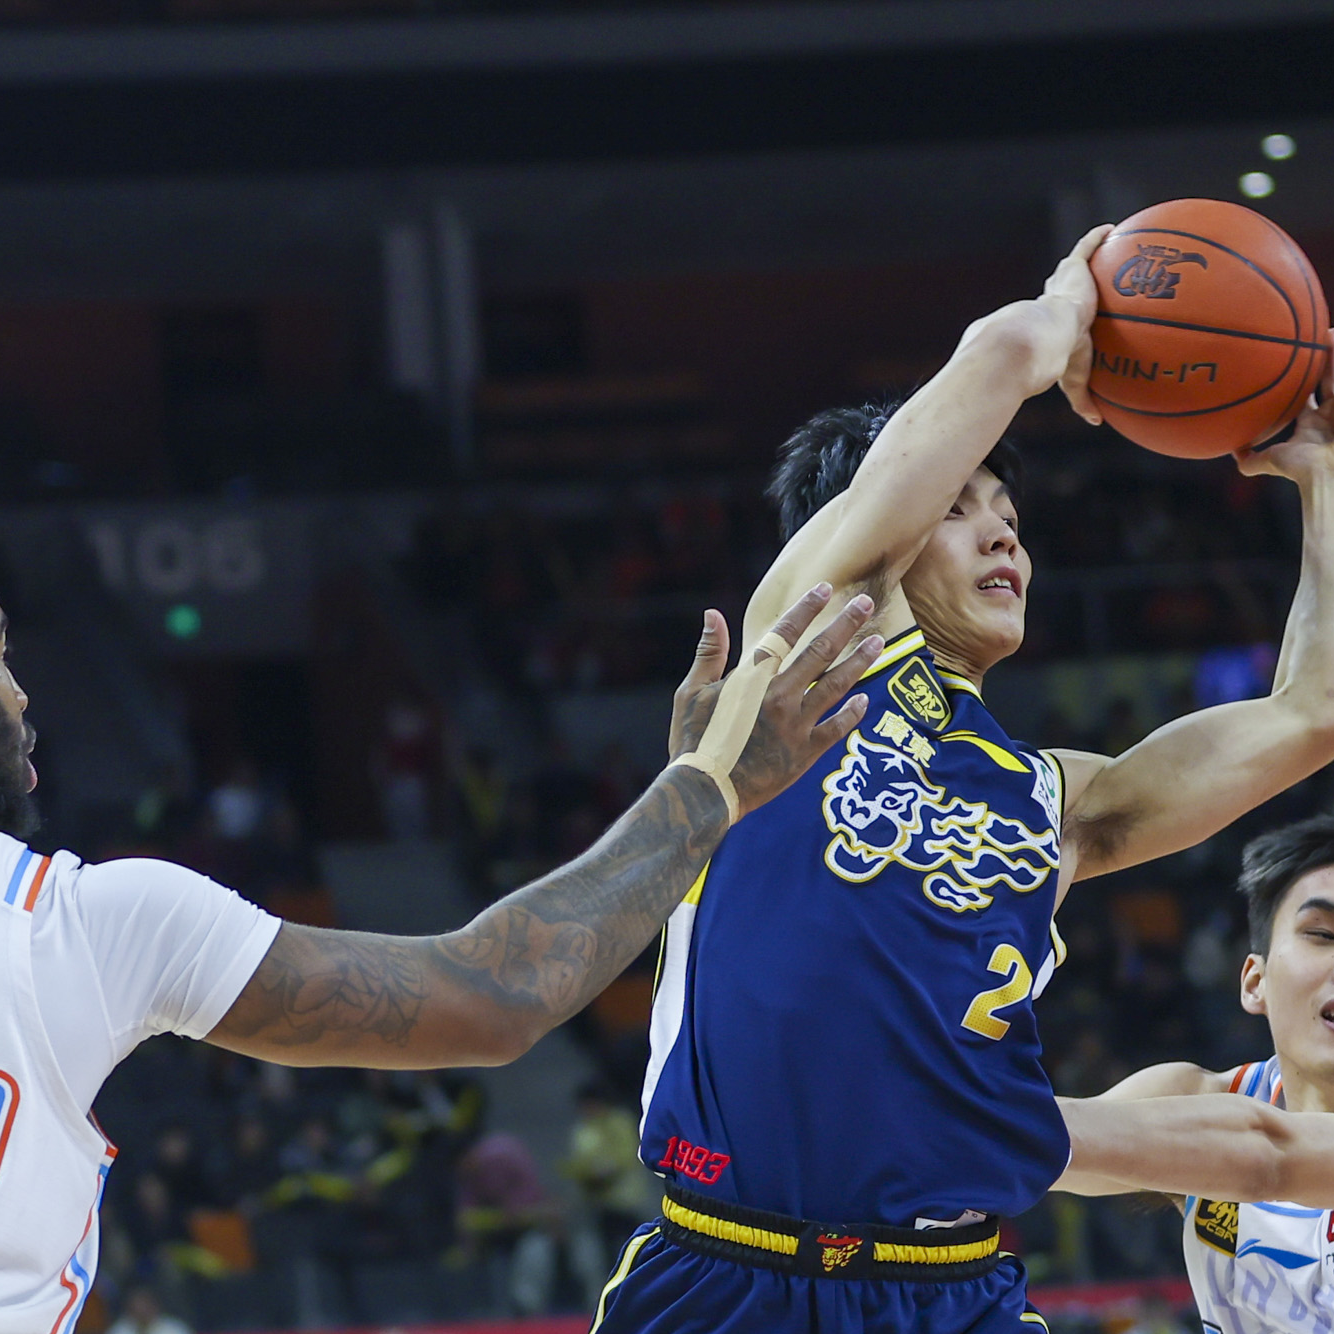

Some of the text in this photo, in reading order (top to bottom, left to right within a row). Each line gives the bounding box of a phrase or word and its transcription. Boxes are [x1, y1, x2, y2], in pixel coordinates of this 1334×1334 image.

[1093, 350, 1217, 382] LI-NIN
[961, 943, 1033, 1041] 2
[658, 1136, 731, 1185] 1993
[1206, 1221, 1234, 1243] CBA
